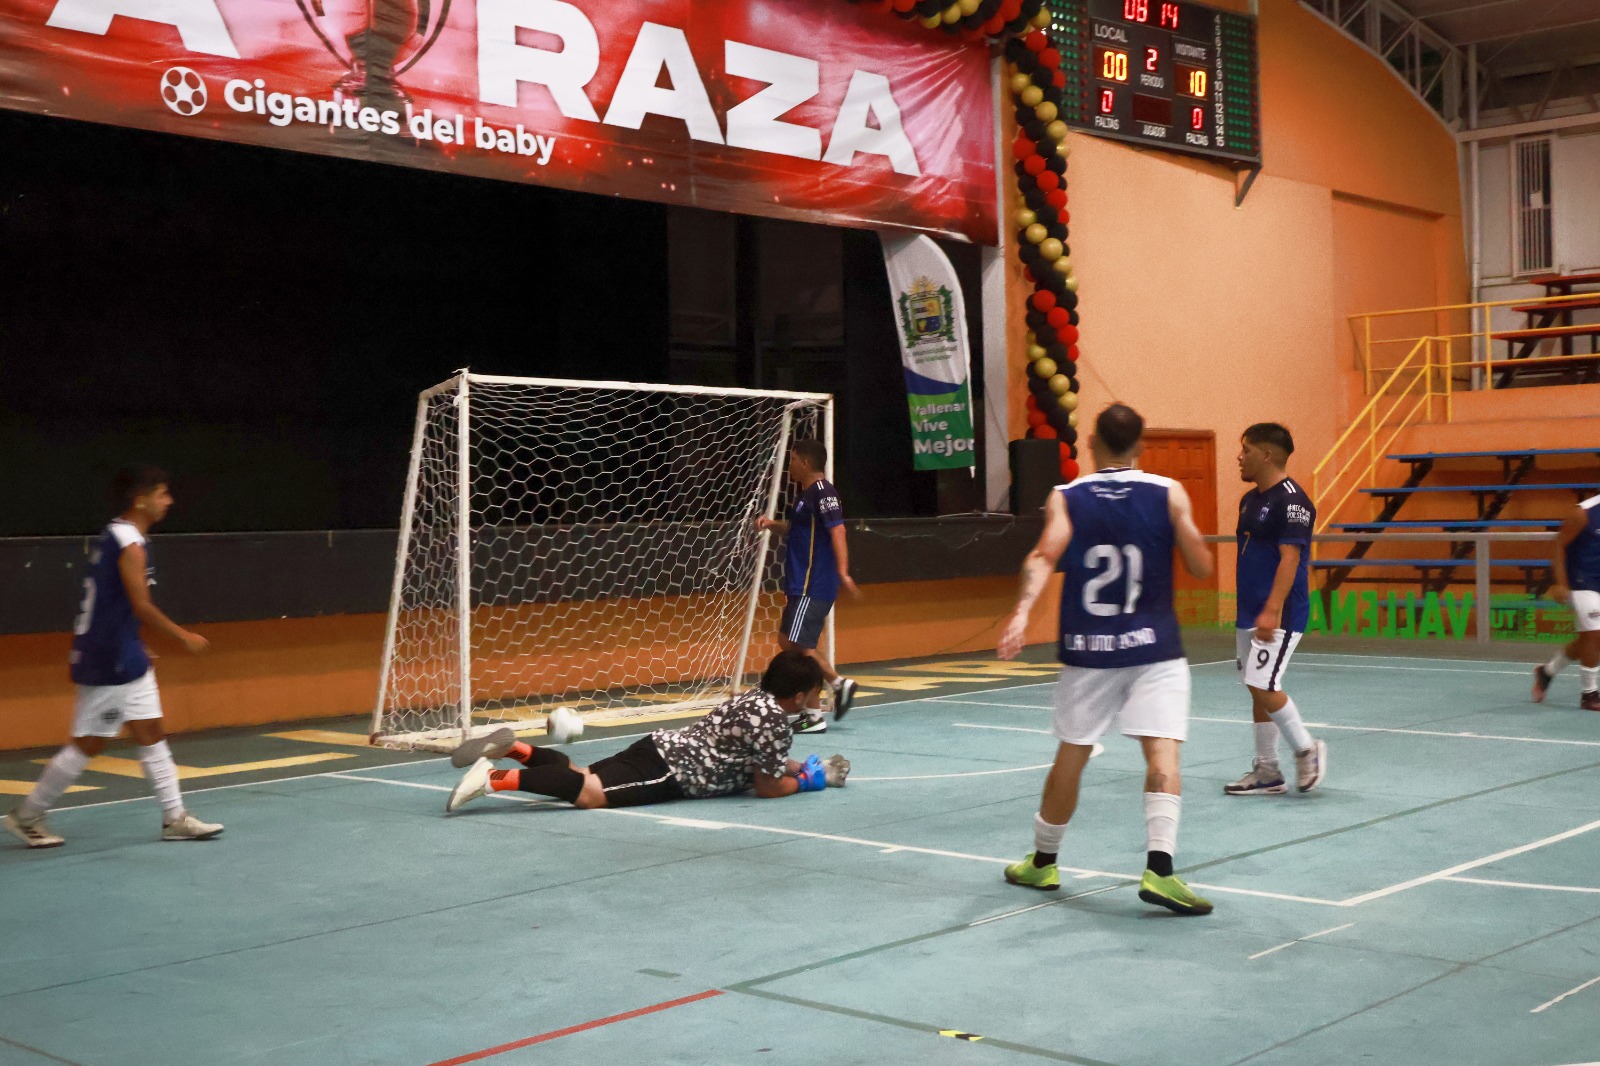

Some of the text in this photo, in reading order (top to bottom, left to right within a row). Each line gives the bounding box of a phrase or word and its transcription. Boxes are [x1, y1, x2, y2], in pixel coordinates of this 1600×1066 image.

[1161, 4, 1178, 28] 14
[1095, 24, 1128, 43] LOCAL
[1103, 51, 1127, 81] 00
[1146, 48, 1158, 71] 2
[477, 0, 921, 177] RAZA
[1190, 71, 1206, 97] 10
[1102, 91, 1113, 112] 0
[224, 77, 557, 166] Gigantes del baby
[1192, 107, 1203, 129] 0
[914, 420, 948, 432] Vive
[913, 434, 975, 457] Mejor
[1082, 544, 1144, 617] 21
[1255, 648, 1270, 670] 9
